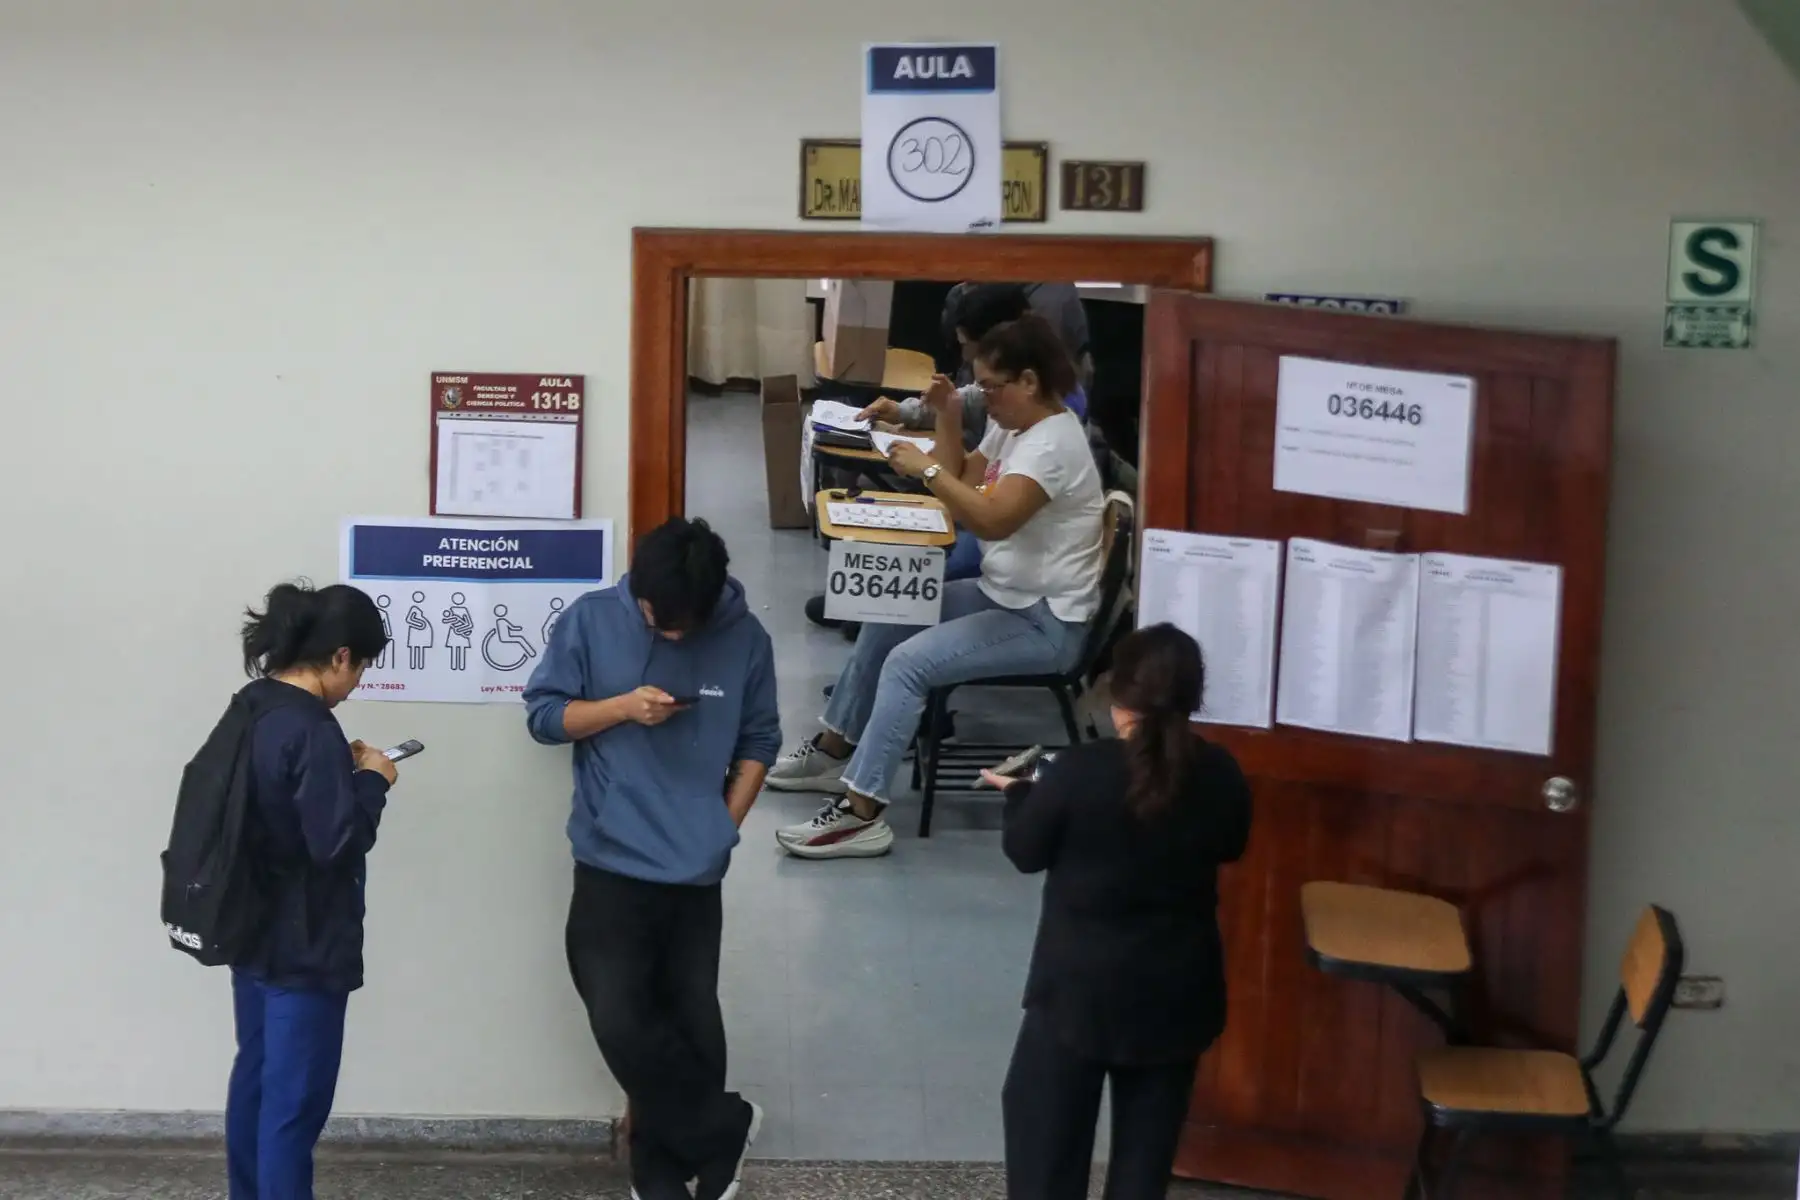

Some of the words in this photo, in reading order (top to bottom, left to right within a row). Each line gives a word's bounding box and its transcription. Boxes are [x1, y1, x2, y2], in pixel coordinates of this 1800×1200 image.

[894, 54, 975, 79] AULA
[900, 134, 967, 176] 302
[1073, 165, 1131, 209] 131
[1681, 226, 1740, 297] S
[539, 378, 572, 388] AULA
[531, 392, 580, 410] 131-B
[1327, 394, 1422, 426] 036446
[438, 537, 519, 550] ATENCIÓN
[423, 555, 533, 569] PREFERENCIAL
[844, 552, 902, 572] MESA
[830, 571, 938, 601] 036446
